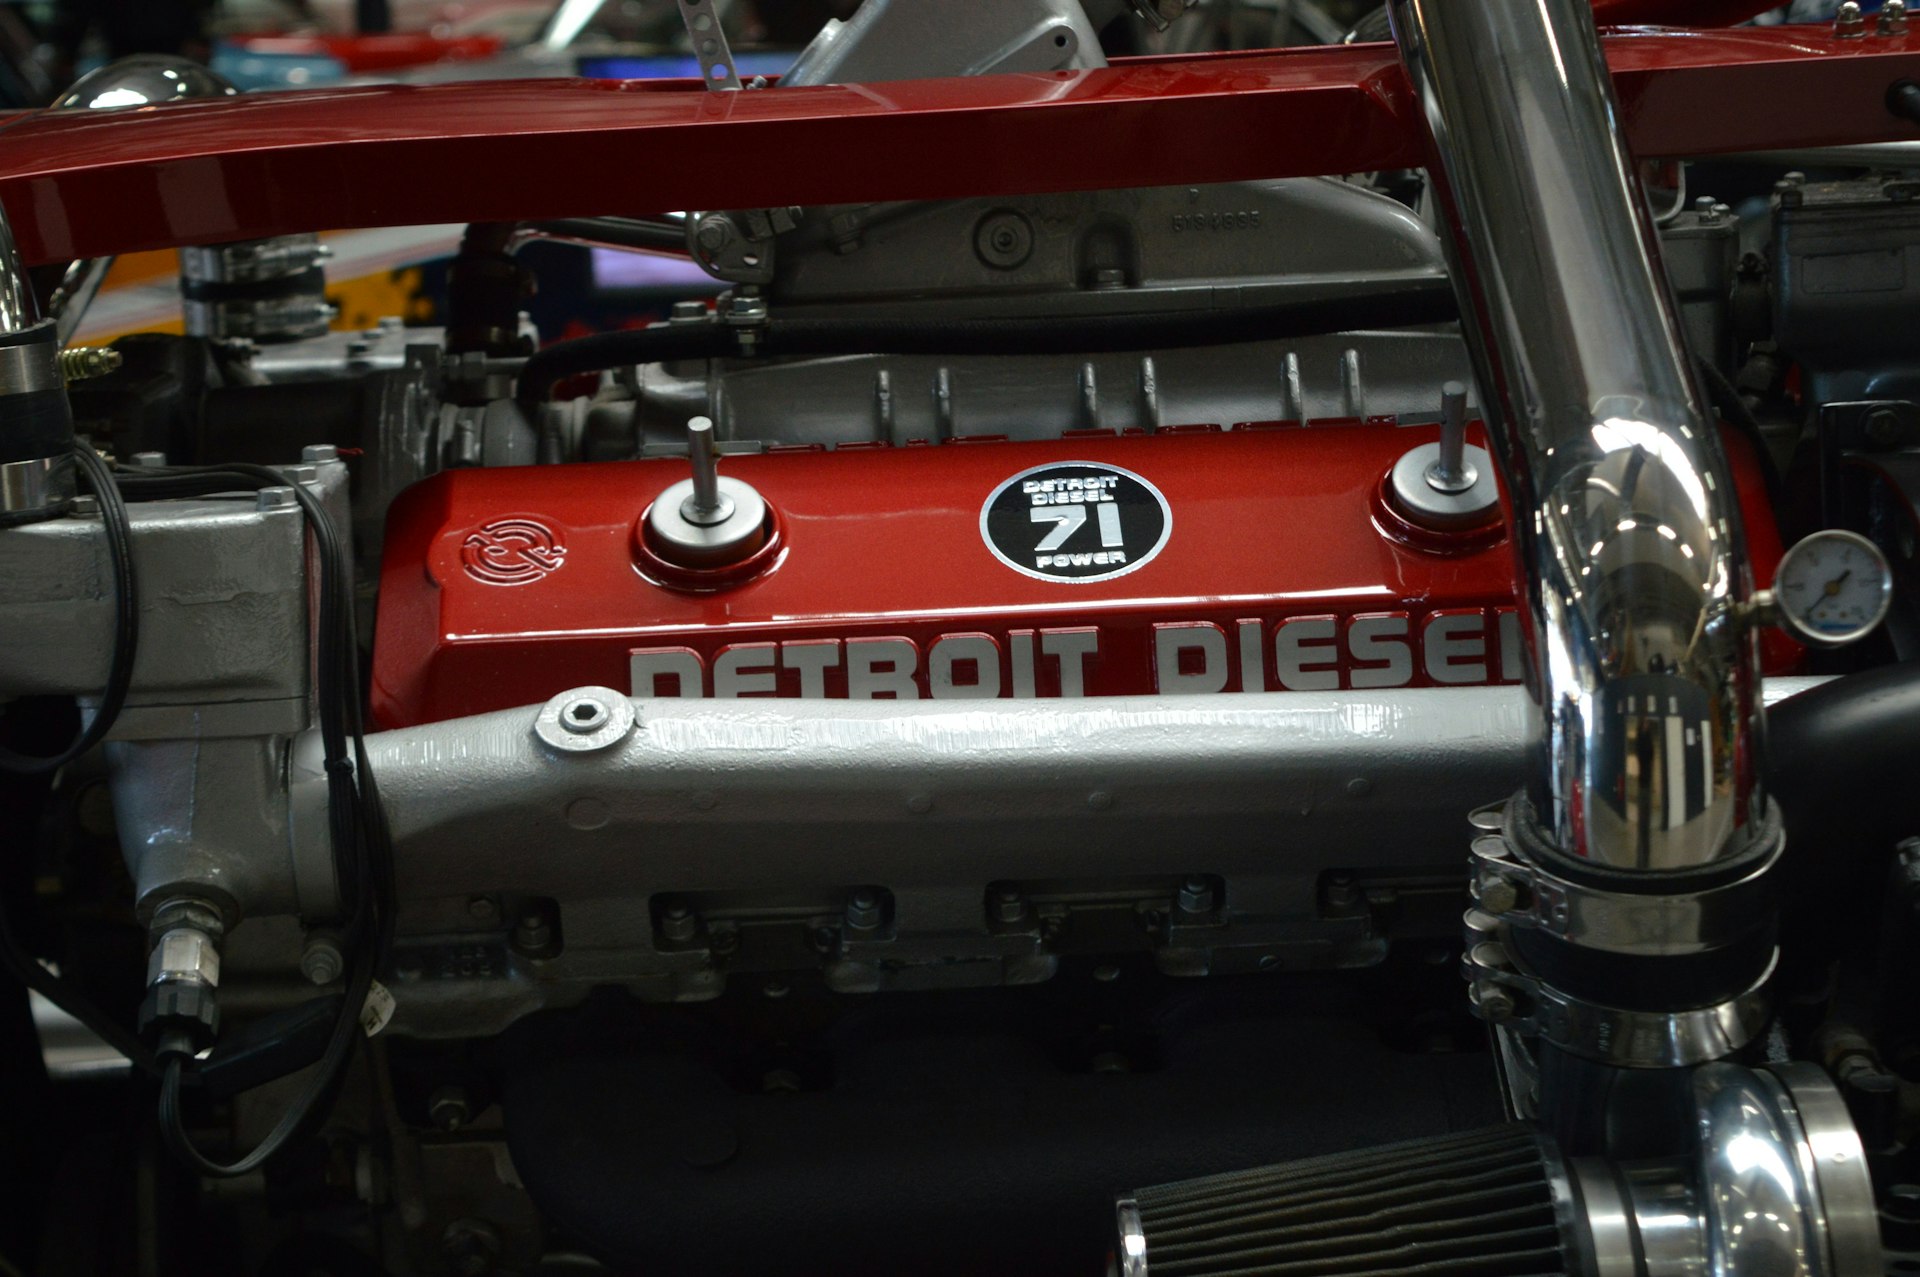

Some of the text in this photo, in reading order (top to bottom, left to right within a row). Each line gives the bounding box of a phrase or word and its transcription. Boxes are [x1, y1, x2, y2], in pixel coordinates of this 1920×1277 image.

[1023, 476, 1119, 494] DETROIT
[1031, 489, 1114, 506] DIESEL
[1030, 502, 1124, 552] 71
[1036, 551, 1127, 568] POWER
[629, 625, 1099, 698] DETROIT
